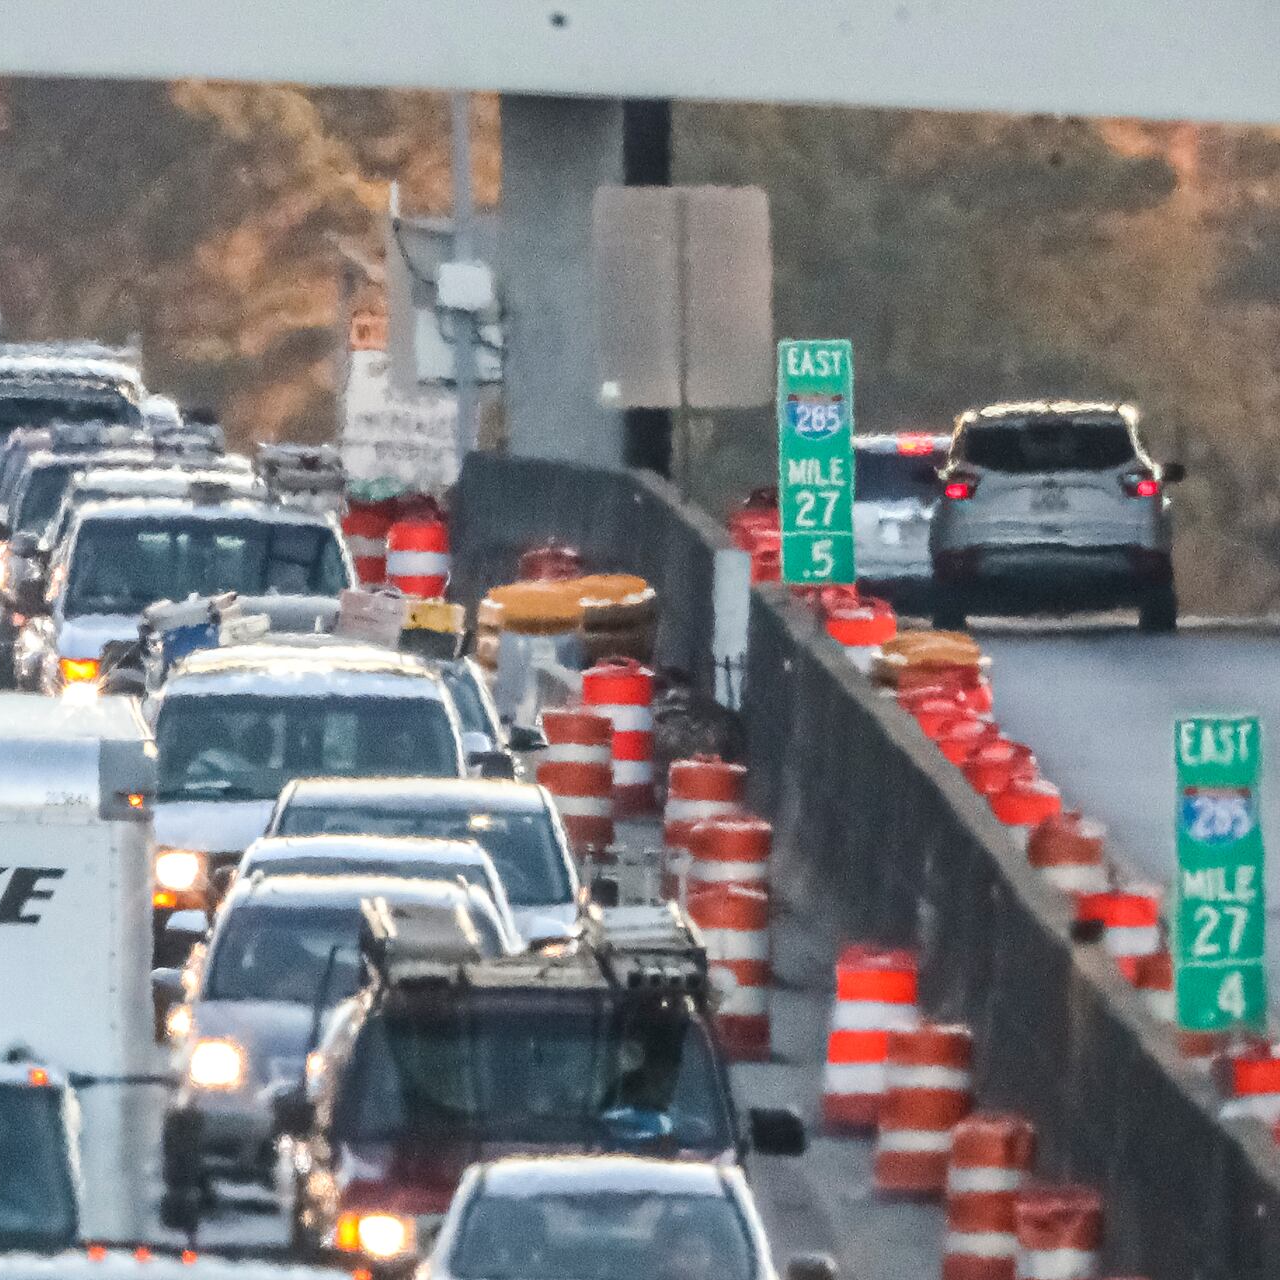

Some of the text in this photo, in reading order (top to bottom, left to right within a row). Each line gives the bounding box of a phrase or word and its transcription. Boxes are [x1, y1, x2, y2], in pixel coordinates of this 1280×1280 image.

[787, 347, 842, 376] EAST
[796, 404, 840, 433] 285
[788, 457, 845, 487] MILE
[795, 489, 840, 527] 27
[1180, 721, 1252, 766] EAST
[1183, 865, 1256, 903] MILE
[1193, 905, 1248, 957] 27
